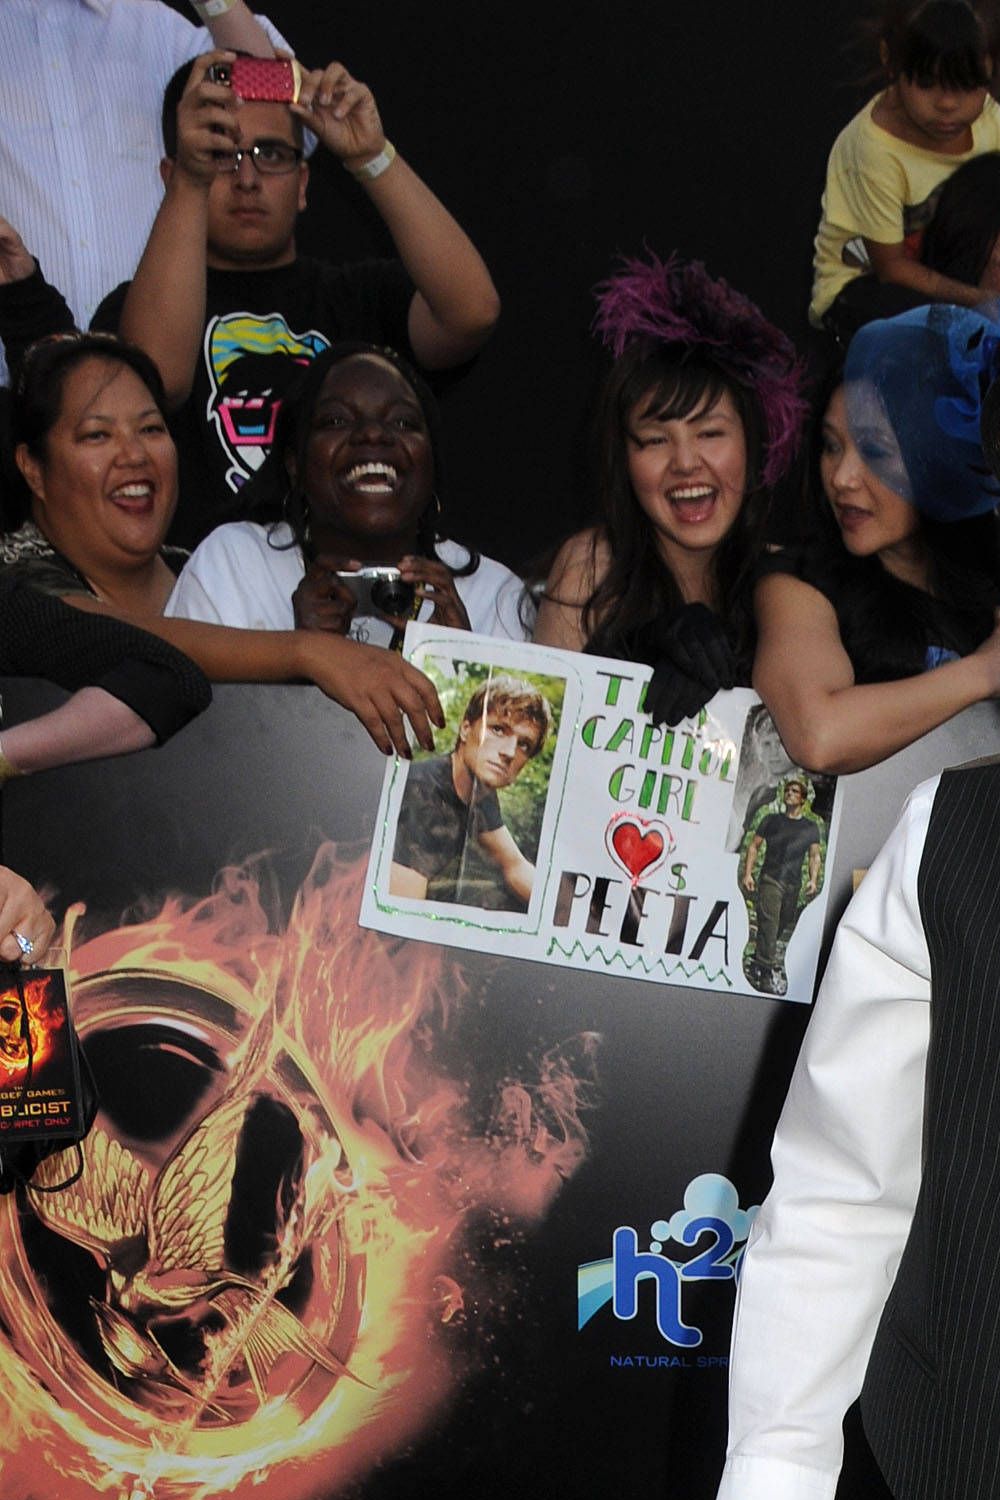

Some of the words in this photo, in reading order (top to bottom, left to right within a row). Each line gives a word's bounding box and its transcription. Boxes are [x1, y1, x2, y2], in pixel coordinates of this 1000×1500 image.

[581, 715, 735, 784] CAPITOL
[608, 763, 700, 825] GIRL
[552, 870, 734, 967] PEETA
[45, 1117, 71, 1127] ONLY
[613, 1217, 748, 1348] h2
[609, 1355, 693, 1368] NATURAL
